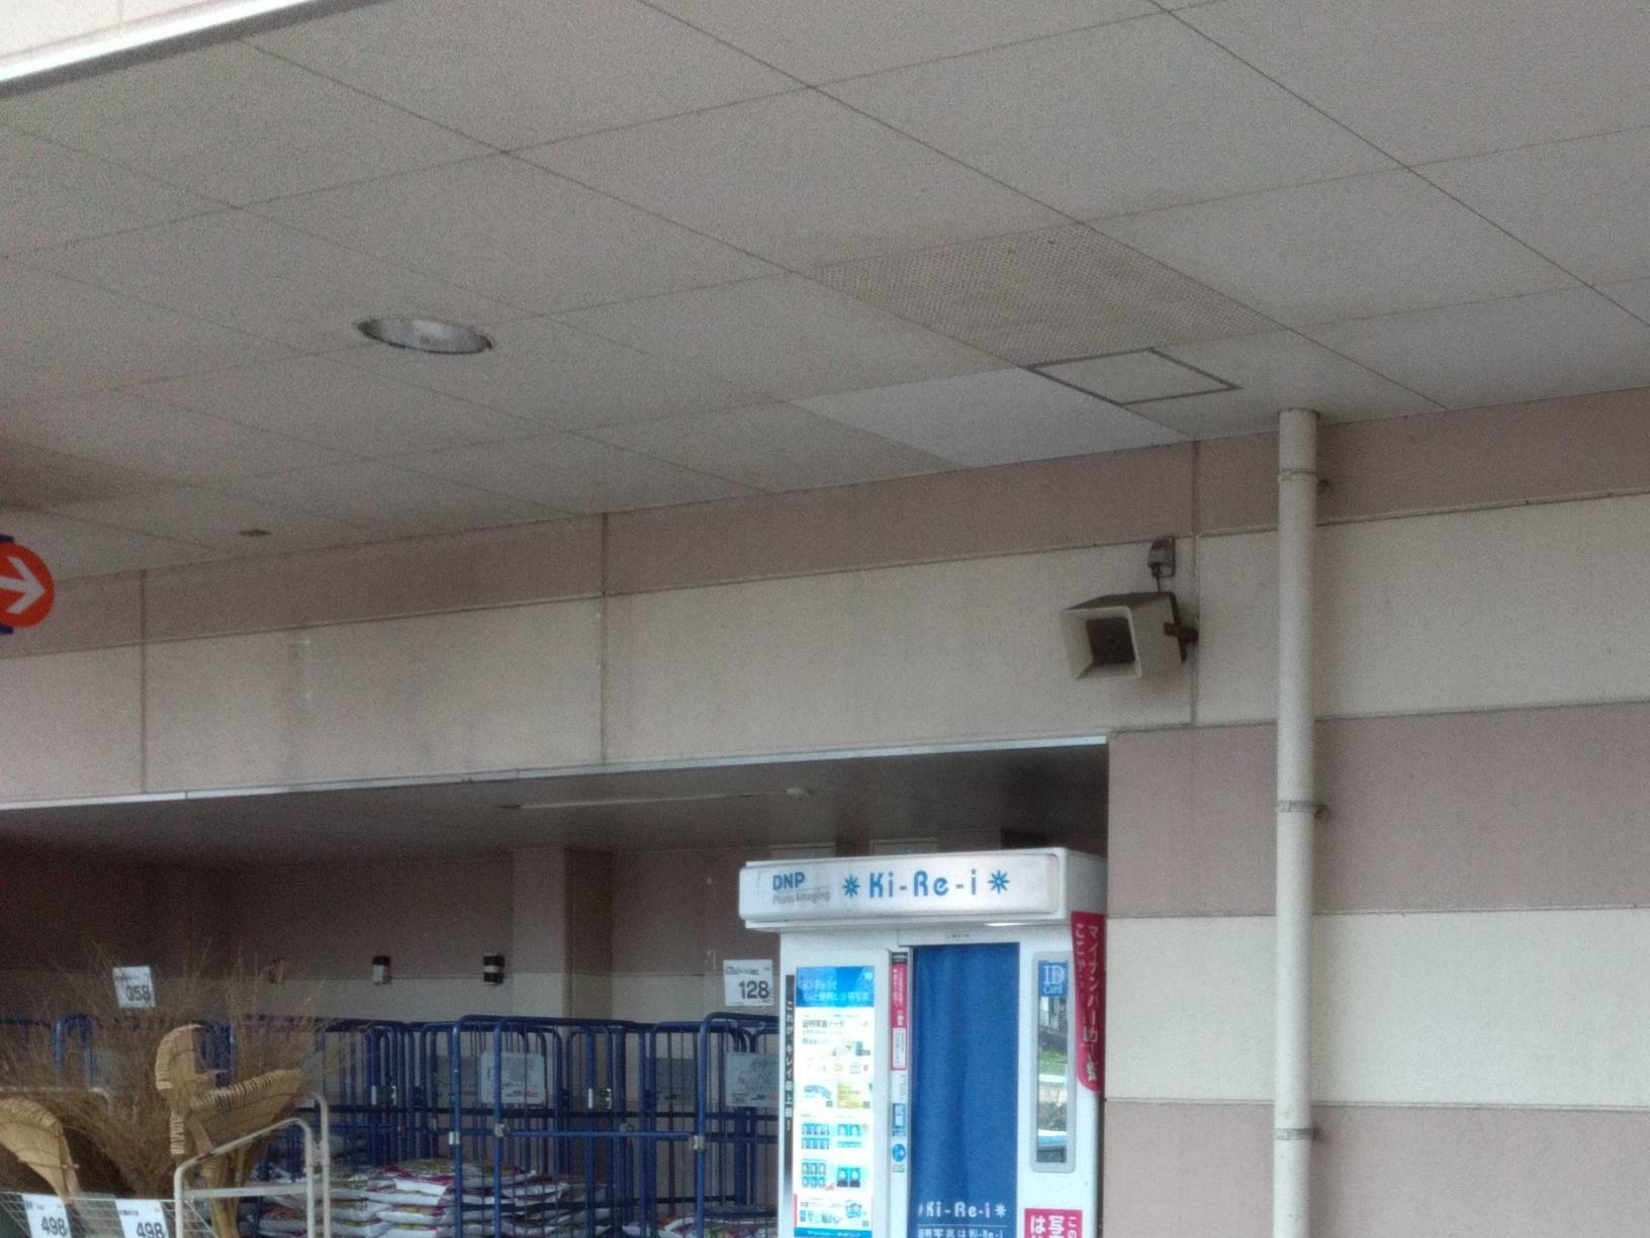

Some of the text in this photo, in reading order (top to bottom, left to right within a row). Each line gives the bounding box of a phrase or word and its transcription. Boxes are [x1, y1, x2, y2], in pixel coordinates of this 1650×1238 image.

[772, 871, 806, 891] DNP
[868, 869, 978, 898] Ki-Re-i
[1043, 965, 1064, 984] ID
[739, 980, 770, 999] 128
[926, 1200, 991, 1218] Ki-Re-i
[41, 1216, 67, 1237] 498
